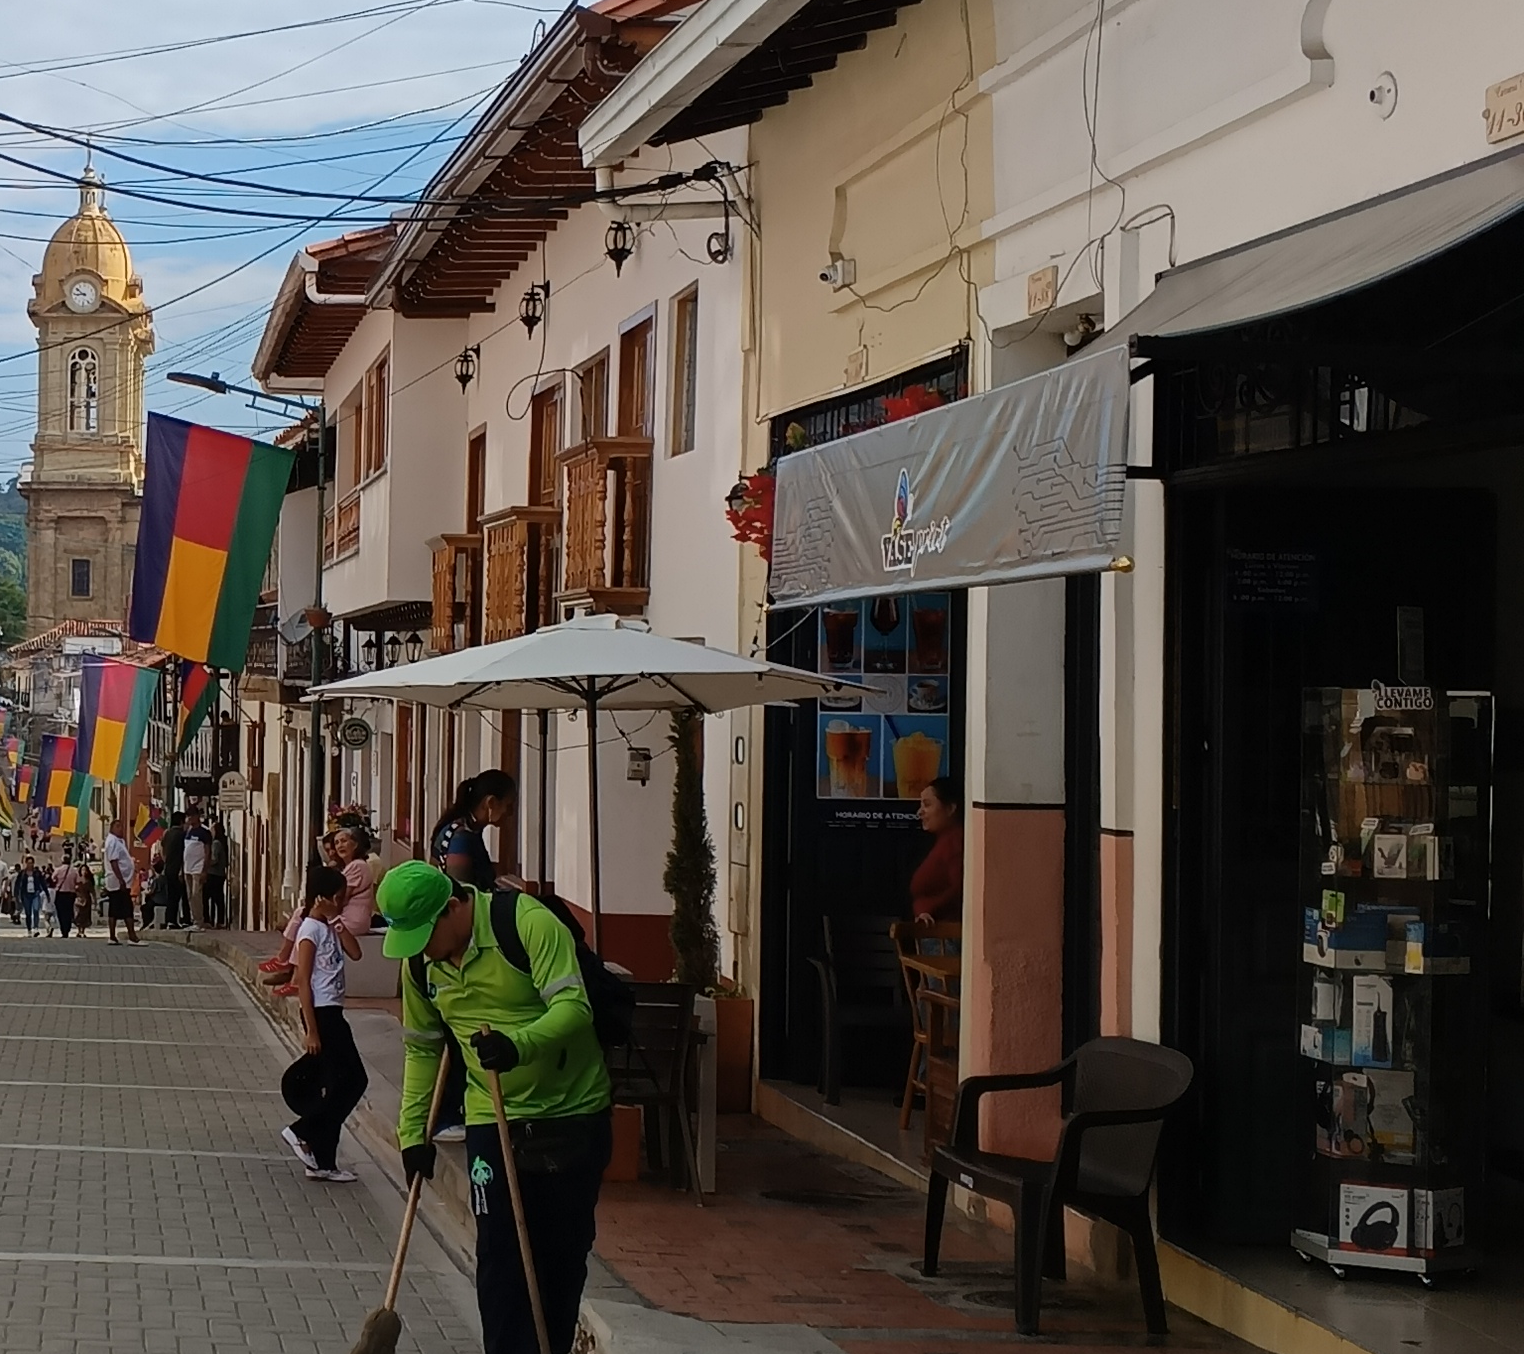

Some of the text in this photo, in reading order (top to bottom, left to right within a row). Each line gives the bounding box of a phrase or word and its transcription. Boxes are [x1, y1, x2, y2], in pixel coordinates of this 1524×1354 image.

[1488, 102, 1524, 136] 11-3
[1377, 697, 1432, 708] CONTIGO
[835, 811, 871, 819] HORARIO
[872, 811, 883, 819] DE
